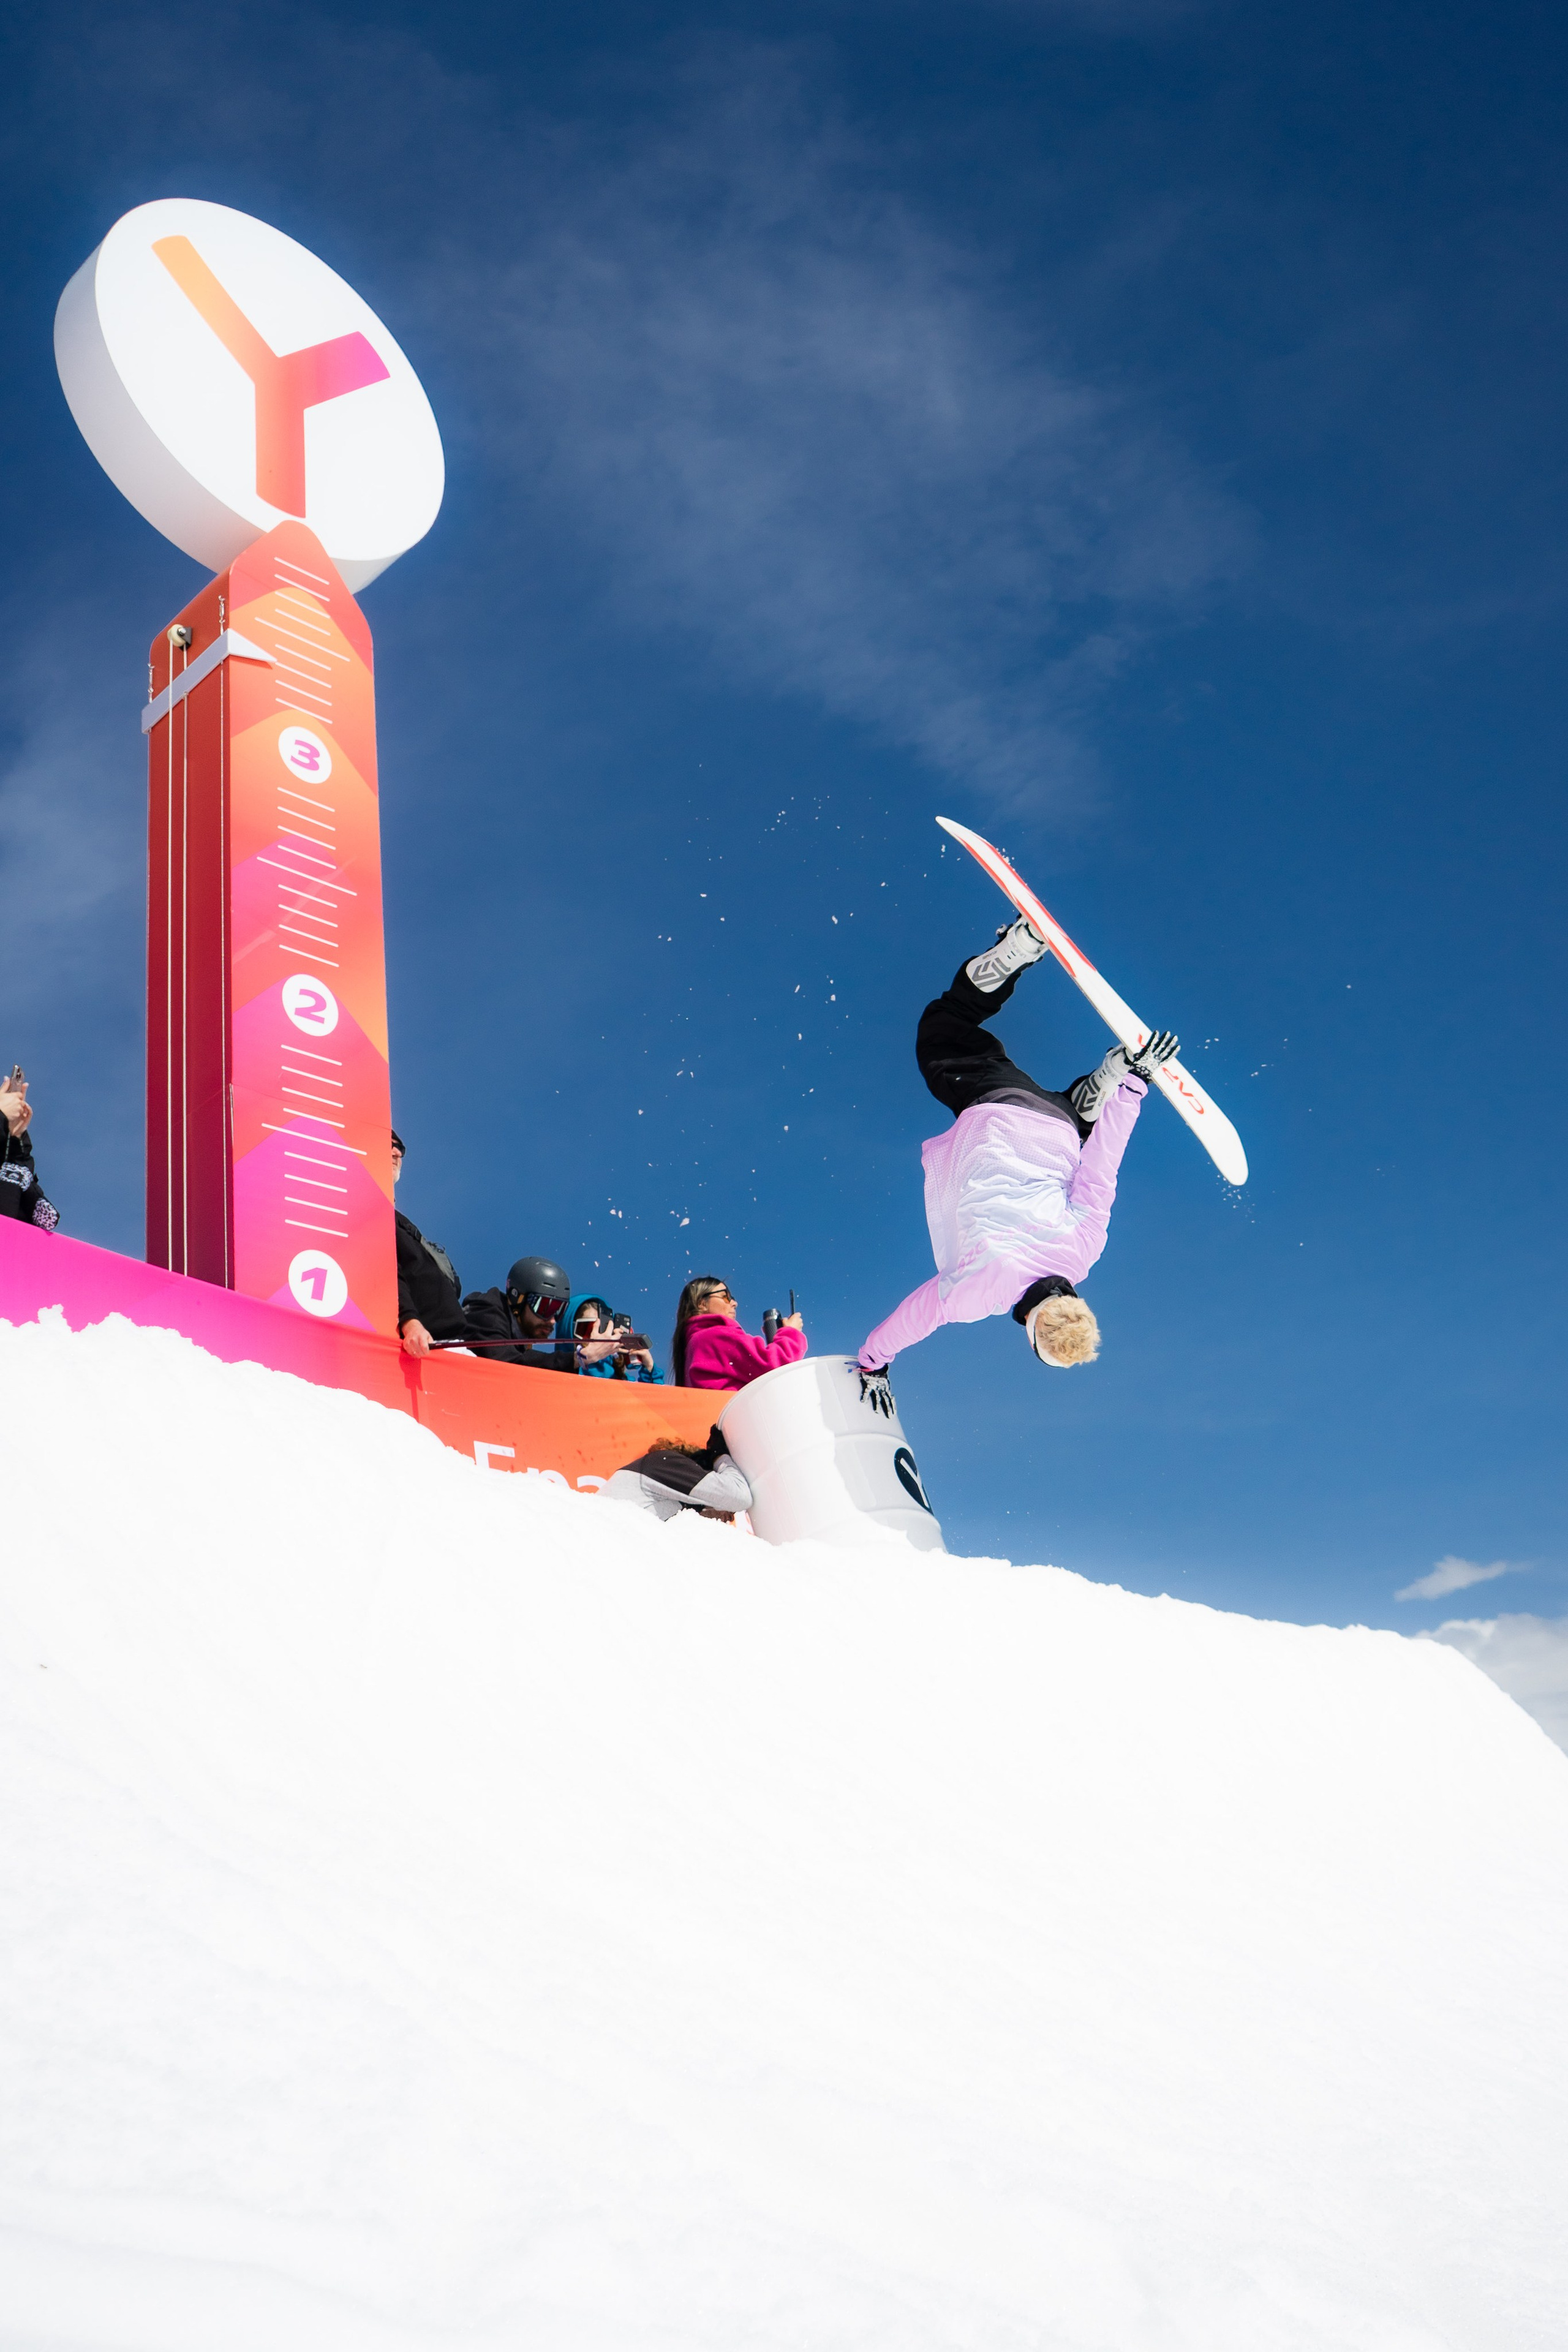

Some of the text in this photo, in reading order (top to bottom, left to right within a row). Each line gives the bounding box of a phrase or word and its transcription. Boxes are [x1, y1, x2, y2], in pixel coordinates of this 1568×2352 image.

[290, 739, 320, 771] 3
[294, 989, 327, 1024] 2
[1137, 1033, 1204, 1115] CAPA
[301, 1267, 328, 1302] 1
